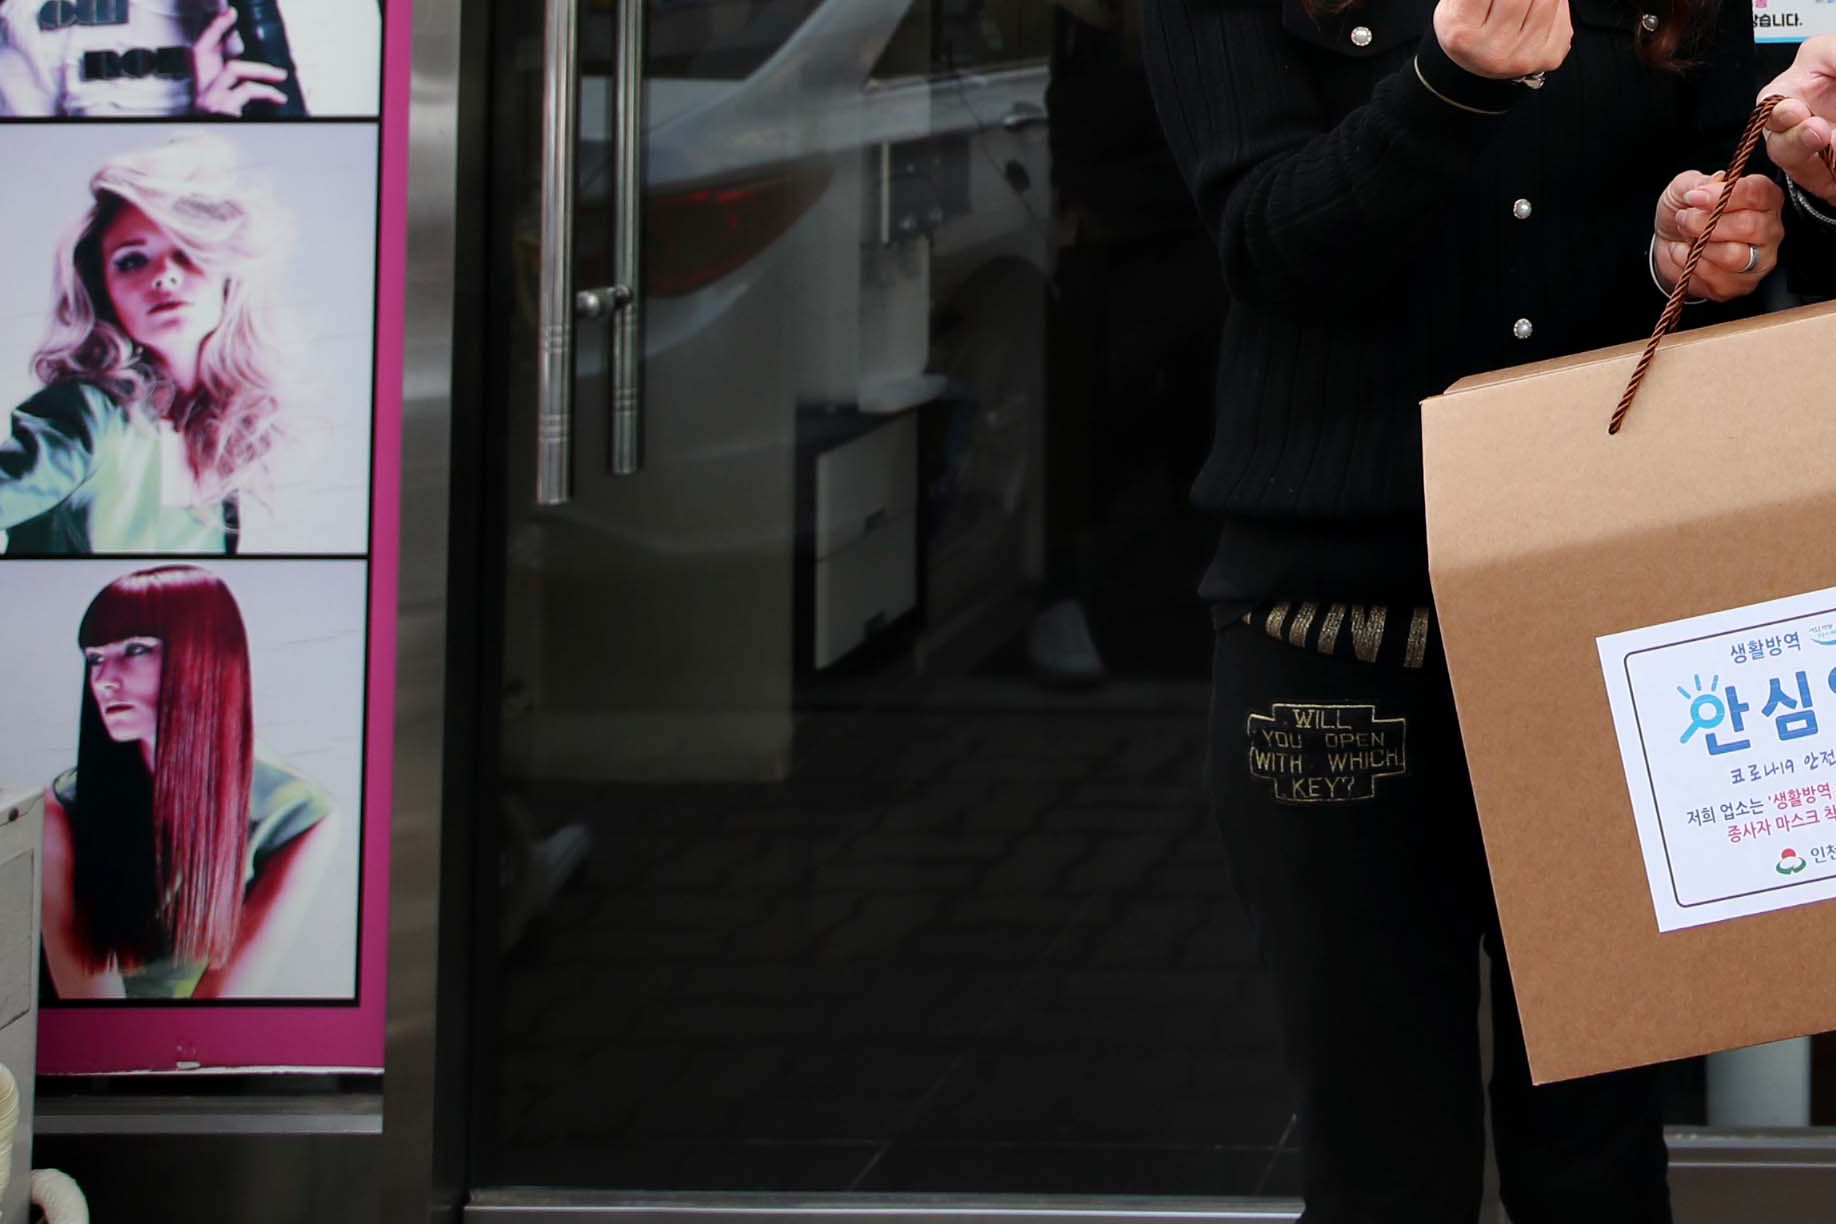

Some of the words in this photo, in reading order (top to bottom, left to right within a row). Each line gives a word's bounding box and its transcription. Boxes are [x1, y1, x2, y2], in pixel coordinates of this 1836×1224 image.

[1730, 631, 1801, 664] 생활방역
[1294, 709, 1352, 729] WILL
[1262, 729, 1302, 749] YOU
[1324, 731, 1386, 748] OPEN
[1254, 751, 1302, 774] WITH
[1327, 749, 1400, 774] WHICH
[1687, 806, 1716, 826] 저희
[1720, 796, 1764, 821] 업소는
[1728, 818, 1771, 843] 종사자
[1776, 810, 1820, 834] 마스크
